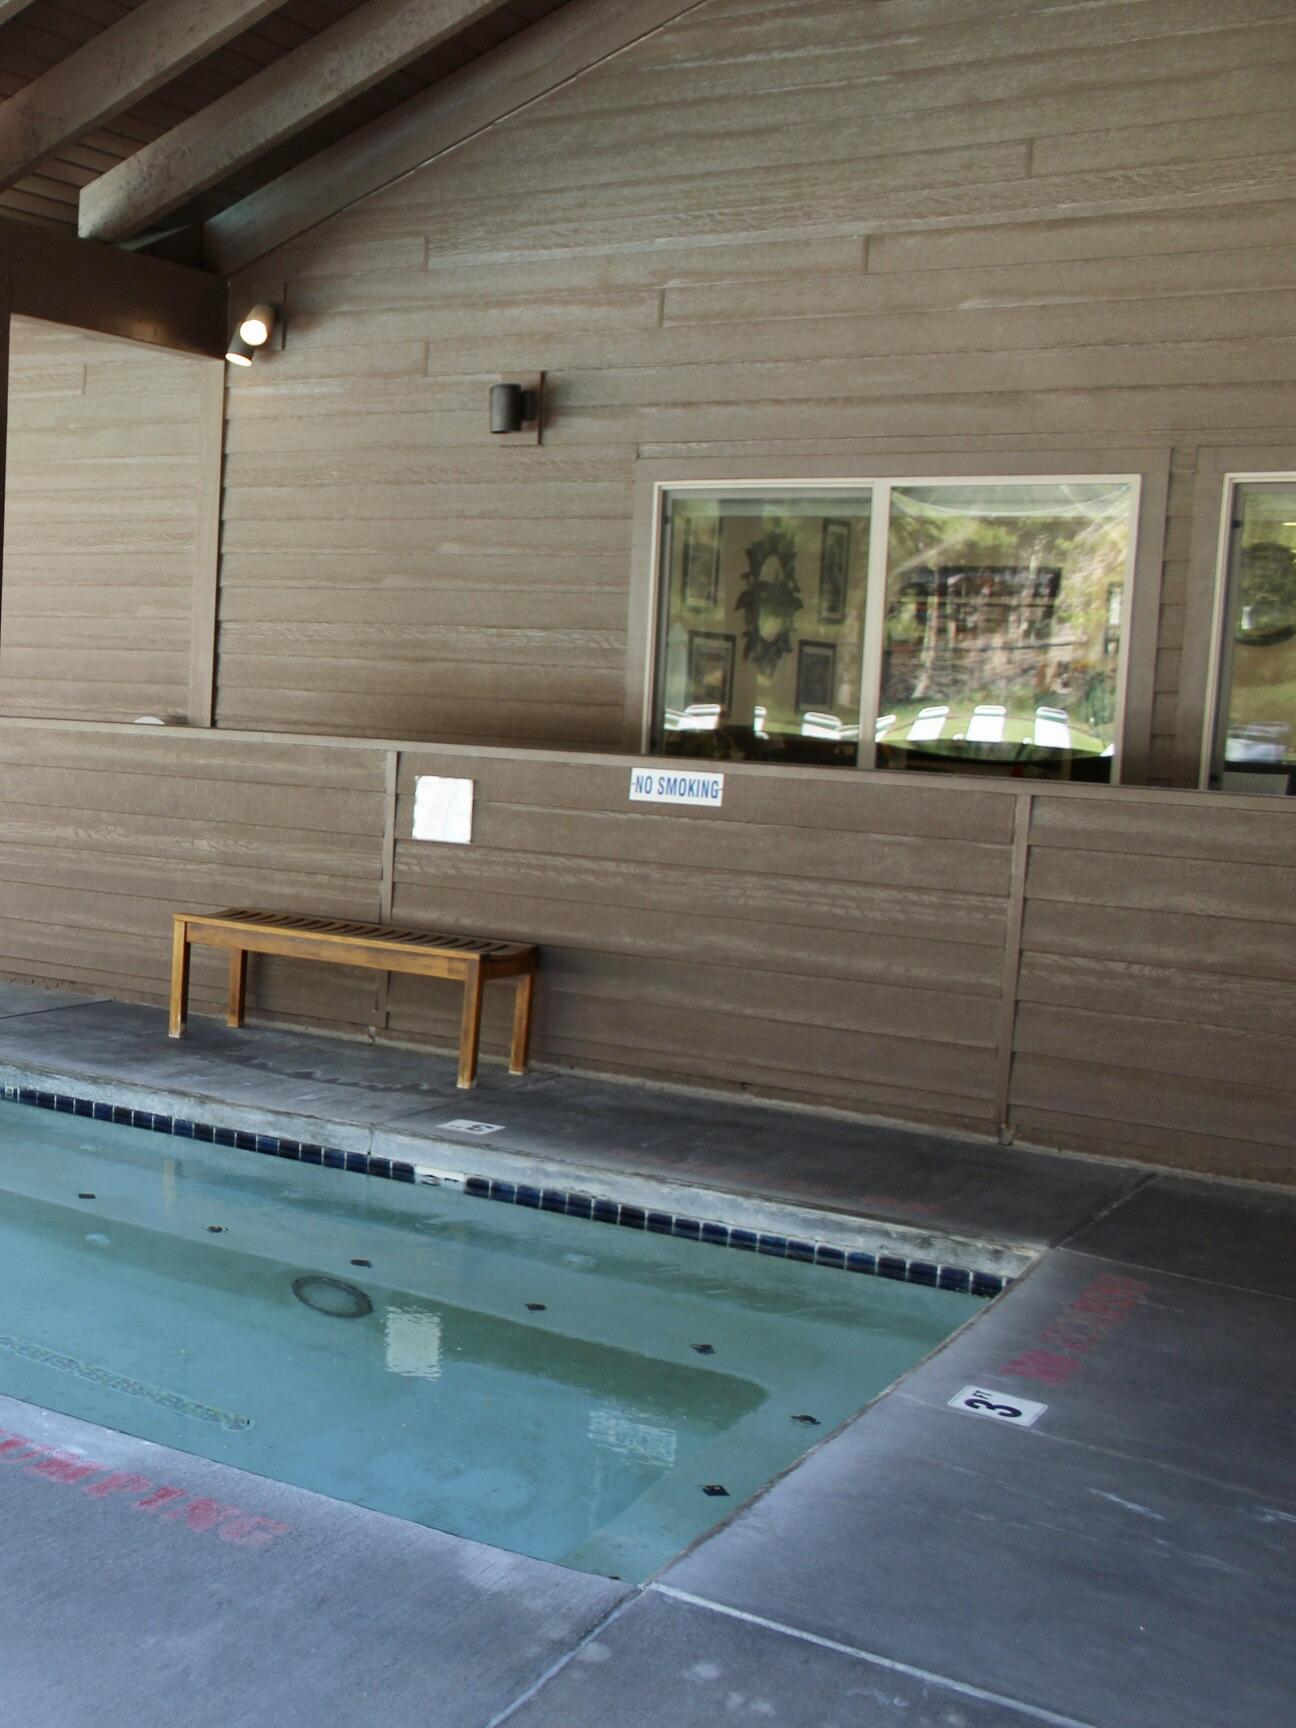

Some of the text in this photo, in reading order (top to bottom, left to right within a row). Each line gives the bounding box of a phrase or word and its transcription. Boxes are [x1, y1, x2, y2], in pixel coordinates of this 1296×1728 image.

[635, 775, 719, 799] NO SMOKING
[964, 1390, 1022, 1418] 3 FT
